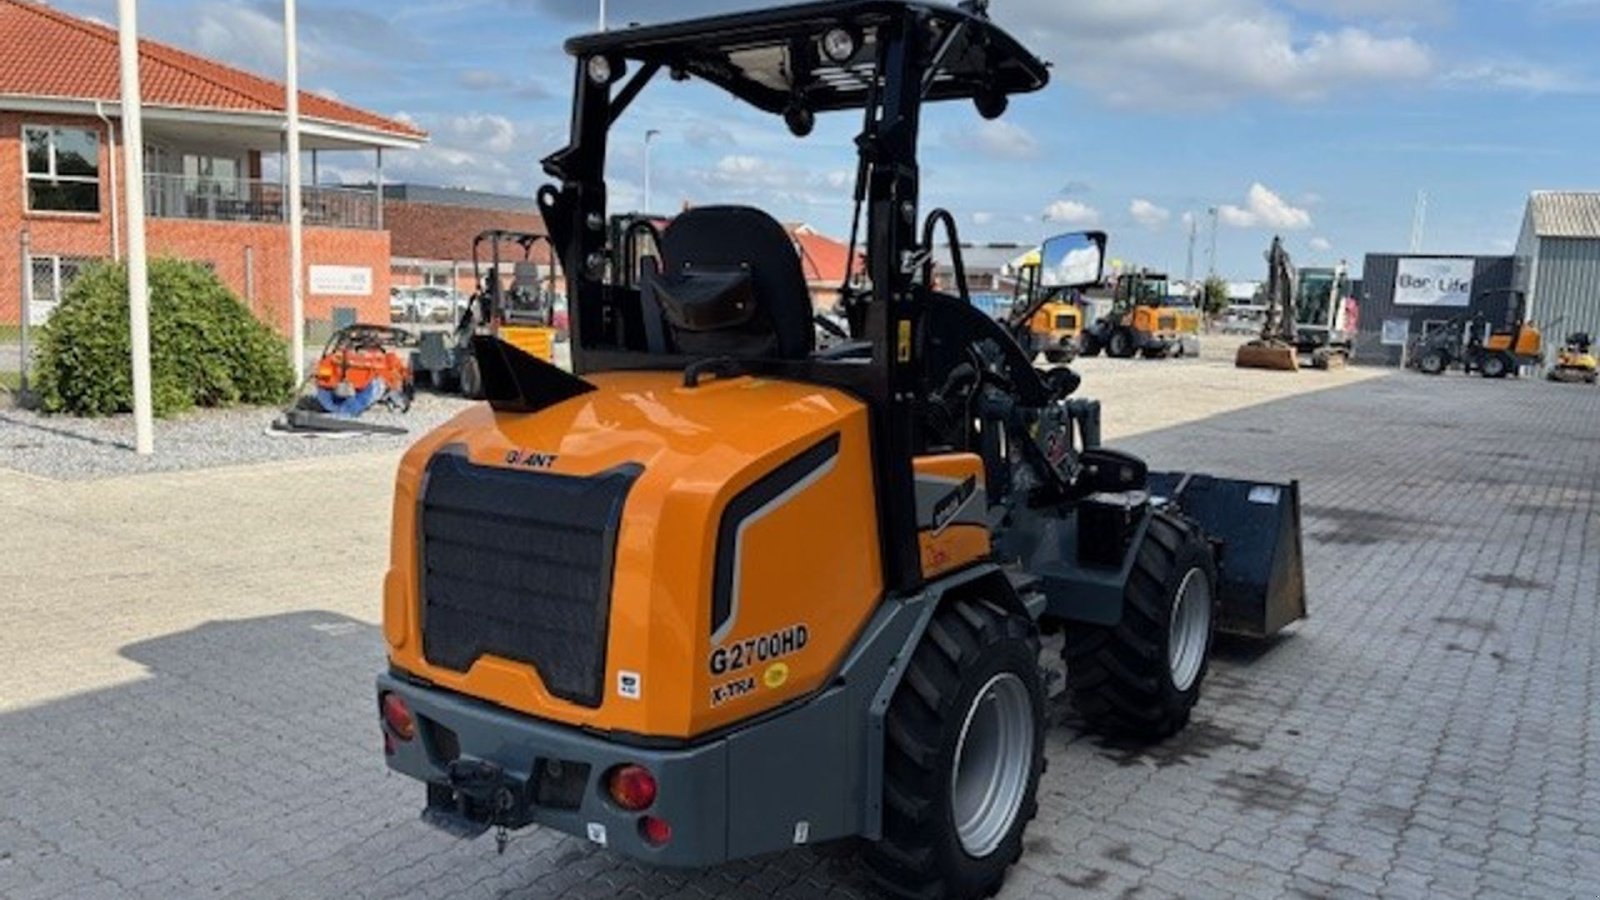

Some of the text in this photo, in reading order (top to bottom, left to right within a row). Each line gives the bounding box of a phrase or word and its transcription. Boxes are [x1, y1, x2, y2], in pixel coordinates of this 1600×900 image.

[1400, 274, 1469, 293] Bar Life
[505, 449, 559, 468] GIANT
[710, 624, 808, 675] G2700HD
[711, 677, 756, 705] X-TRA
